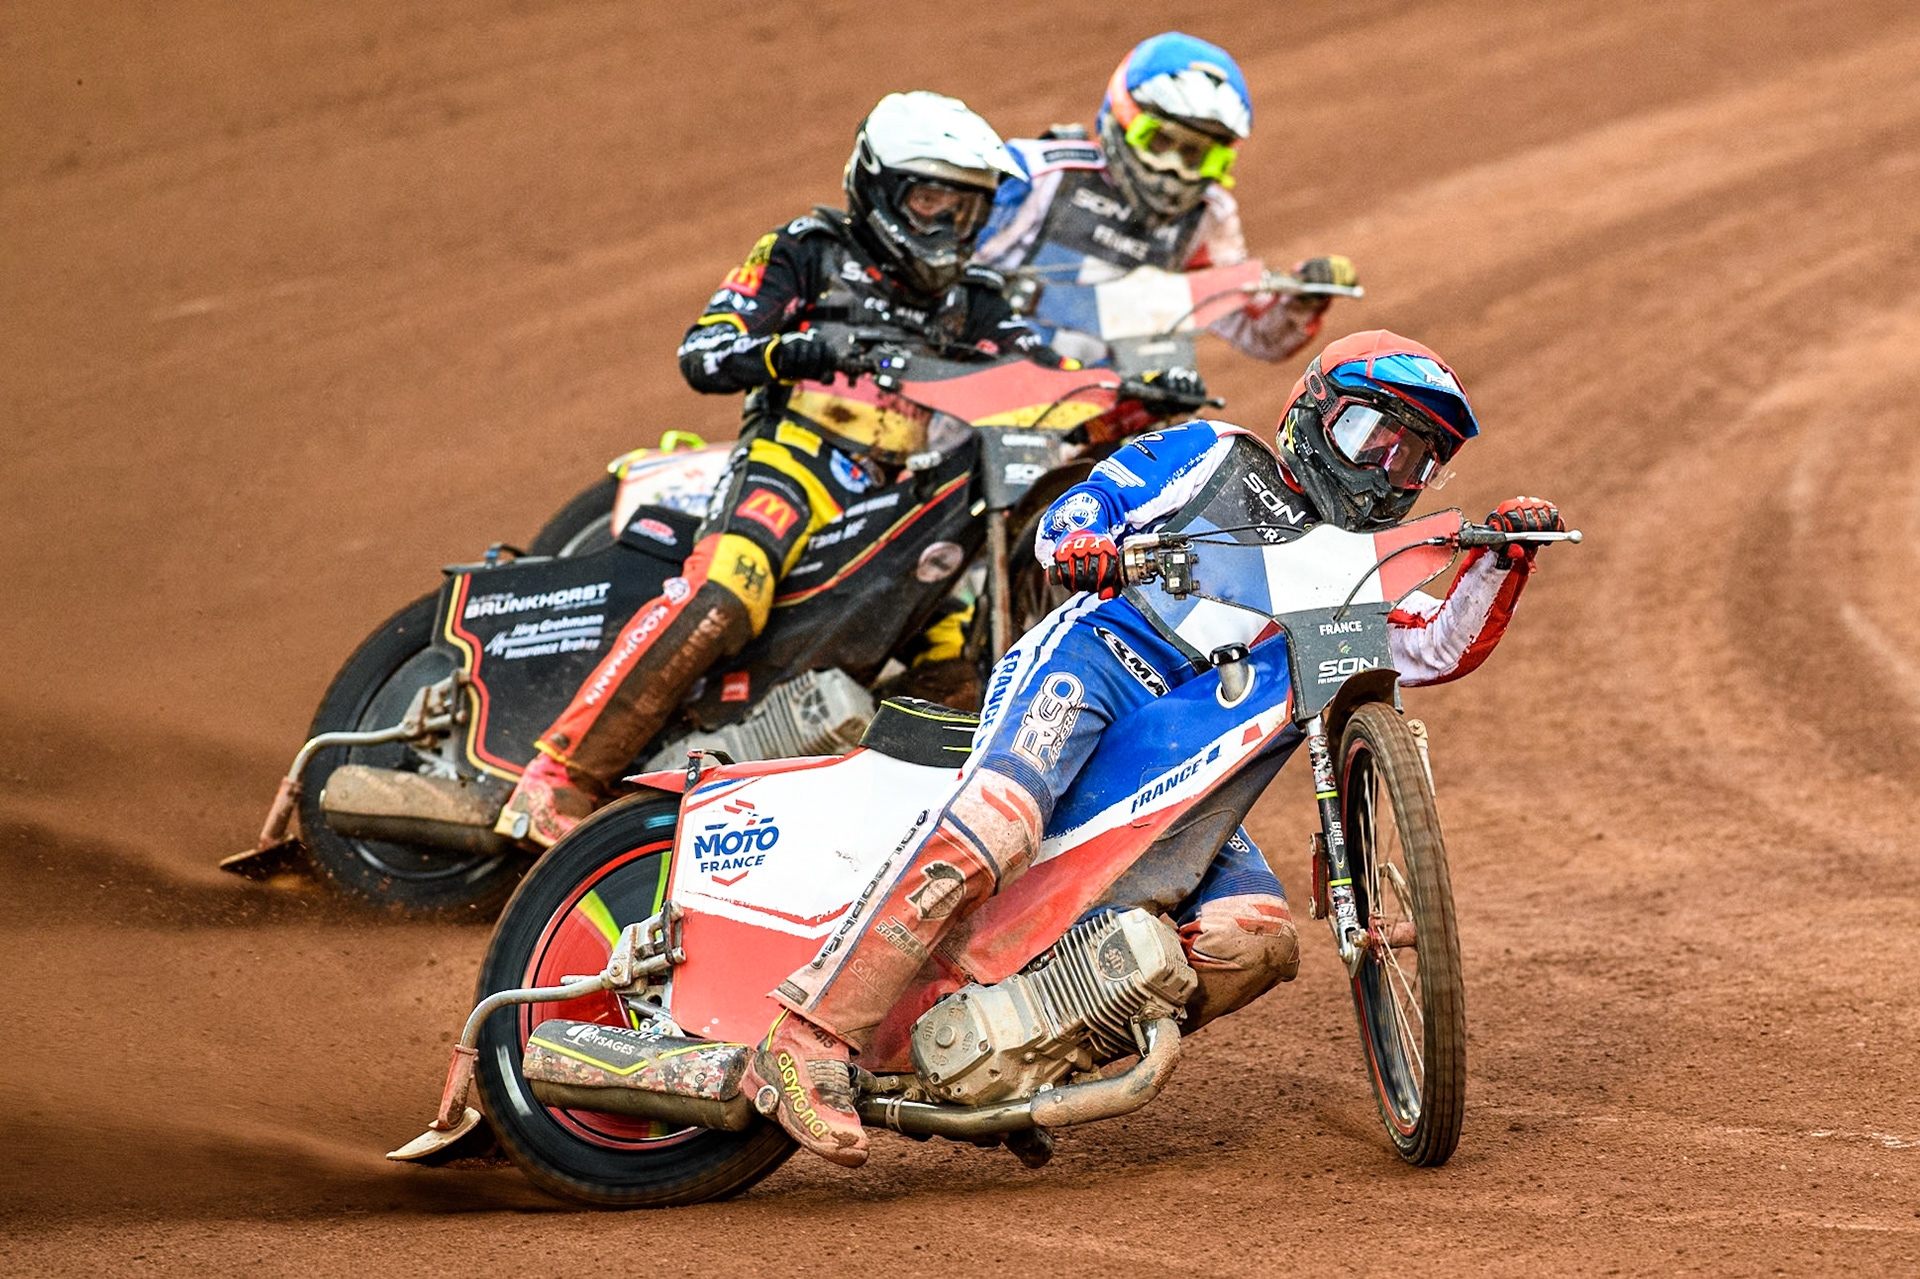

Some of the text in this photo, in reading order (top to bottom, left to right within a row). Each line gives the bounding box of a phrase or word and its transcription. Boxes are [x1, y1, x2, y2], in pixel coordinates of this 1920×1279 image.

[1242, 472, 1306, 525] SON
[1060, 537, 1108, 554] FOX
[464, 582, 611, 619] BRUNKHORST
[1319, 620, 1363, 636] FRANCE
[585, 604, 669, 706] KOOPMANN
[1318, 656, 1379, 679] SON
[979, 649, 1021, 731] FRANCE
[1131, 757, 1203, 814] FRANCE
[694, 826, 780, 859] MOTO
[1330, 820, 1345, 847] BAR
[700, 854, 766, 873] FRANCE
[776, 1051, 831, 1139] daytona
